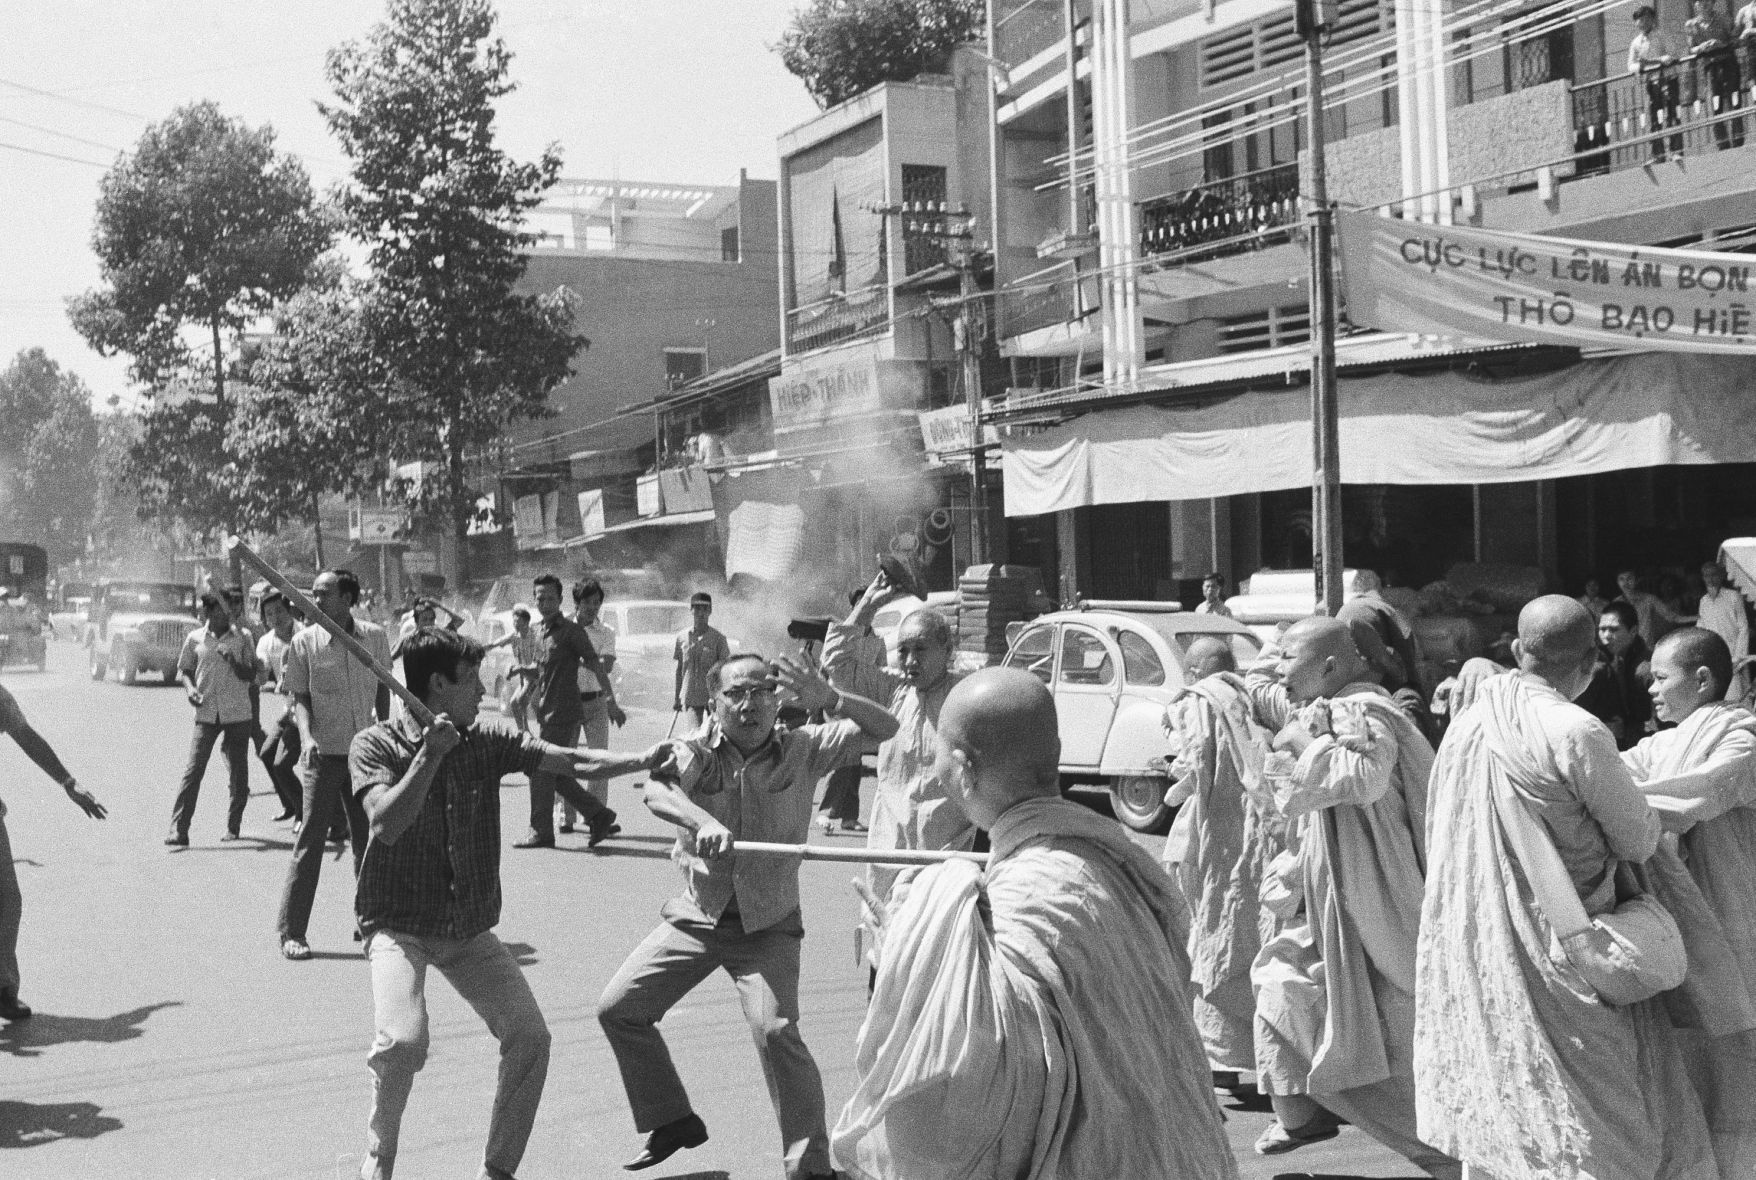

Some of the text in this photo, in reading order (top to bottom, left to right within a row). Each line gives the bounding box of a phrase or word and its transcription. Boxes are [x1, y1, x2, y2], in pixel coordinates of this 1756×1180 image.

[1400, 238, 1466, 273] CỰC
[1552, 248, 1609, 284] LÊN
[1621, 251, 1661, 287] ÁN
[1678, 264, 1749, 298] BỌN
[1493, 291, 1574, 325] THÔ
[1601, 303, 1674, 337] BẠO
